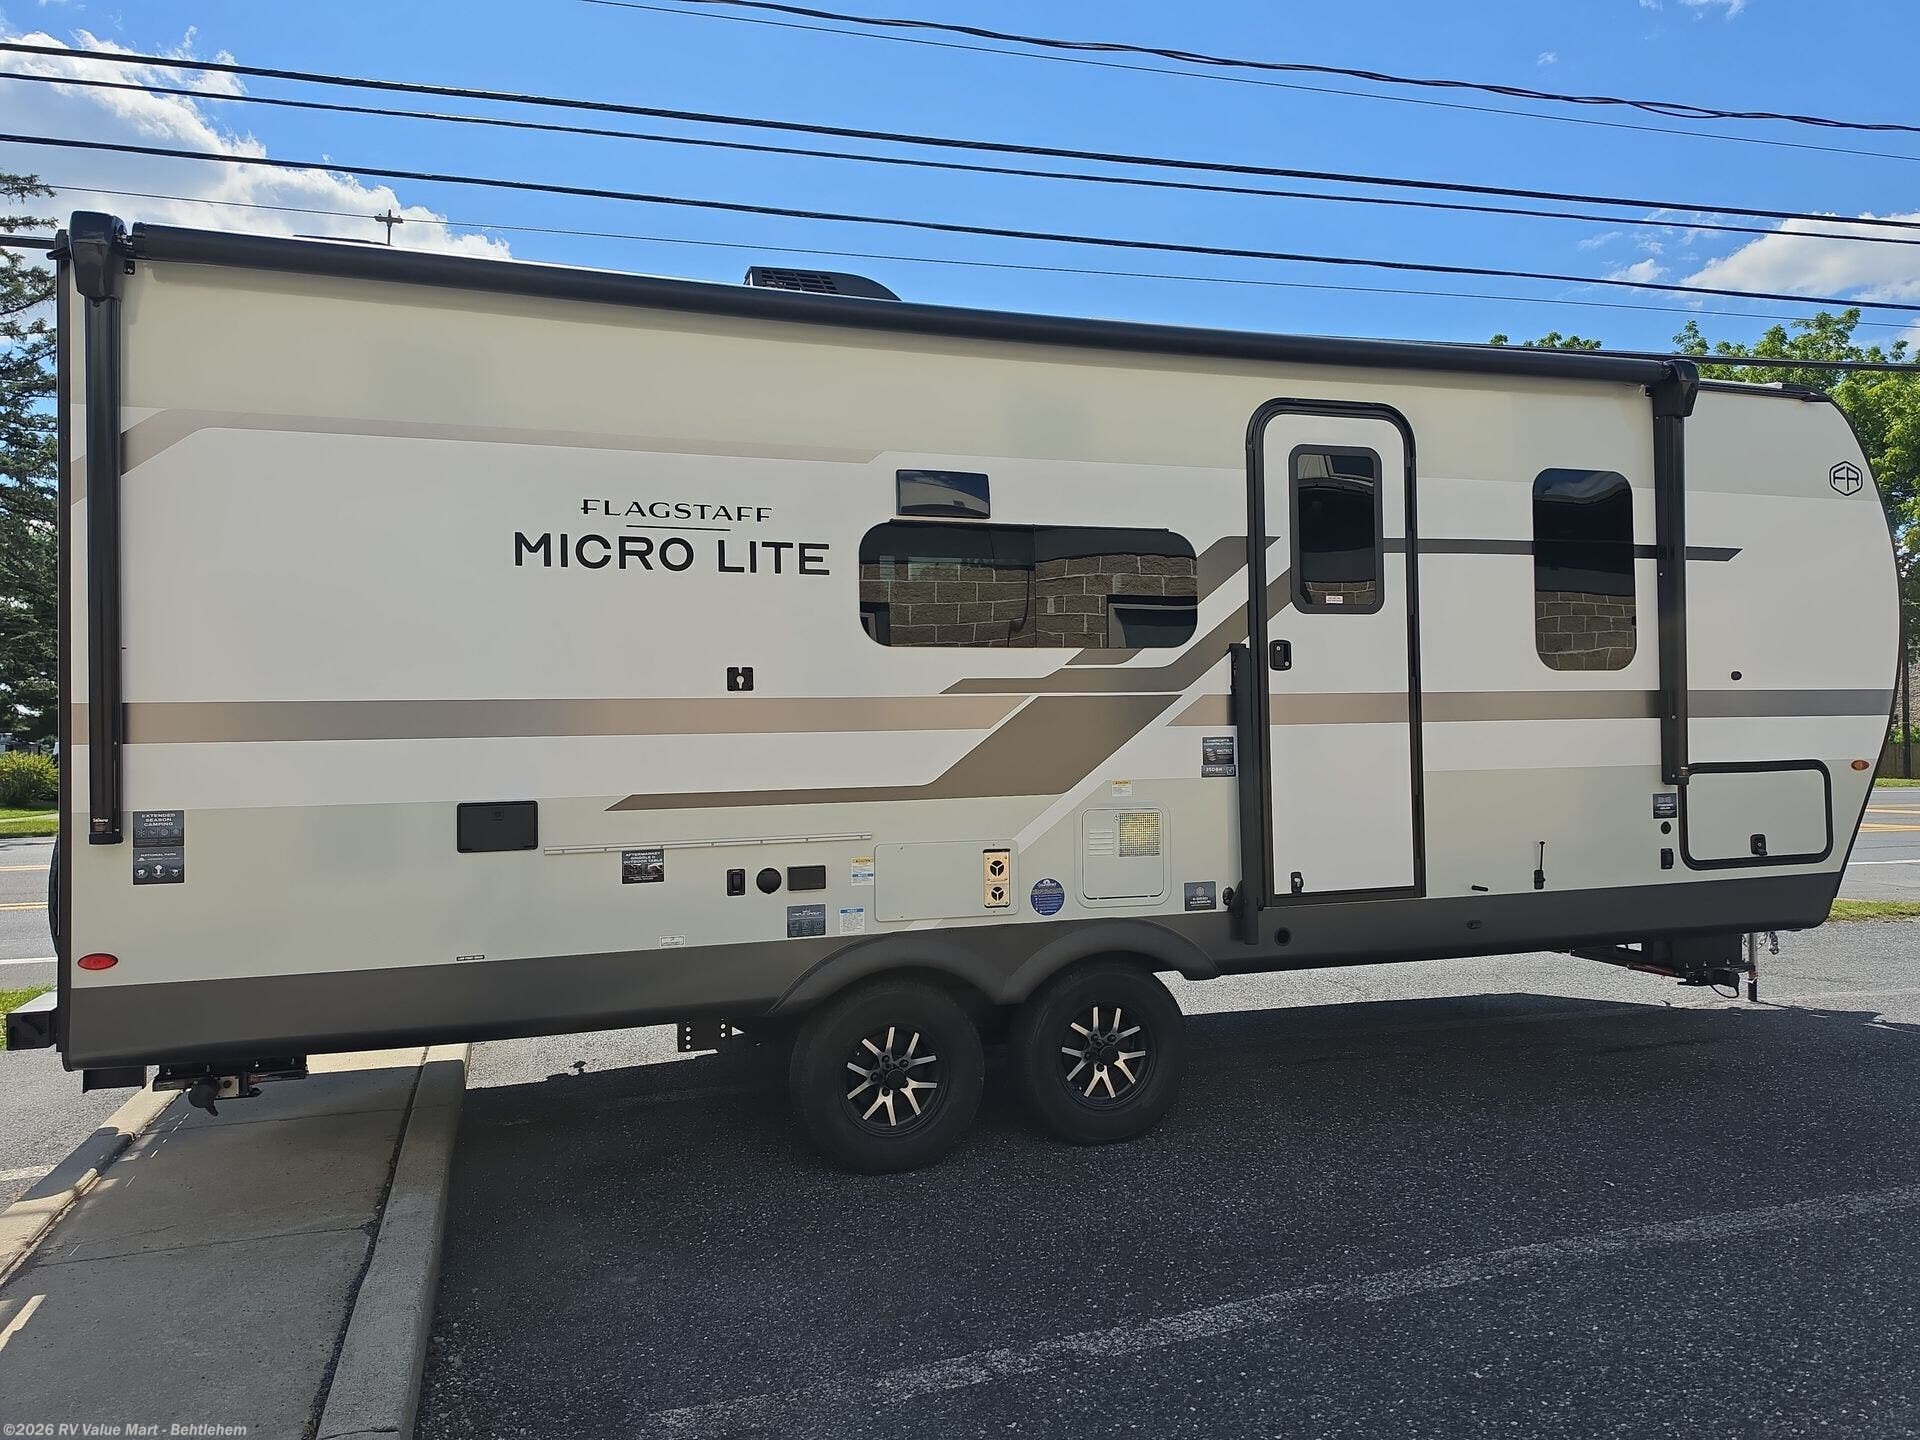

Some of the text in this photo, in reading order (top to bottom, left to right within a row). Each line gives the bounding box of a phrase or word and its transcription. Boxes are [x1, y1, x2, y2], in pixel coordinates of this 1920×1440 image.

[580, 498, 773, 522] FLAGSTAFF
[514, 531, 830, 576] MICRO LITE
